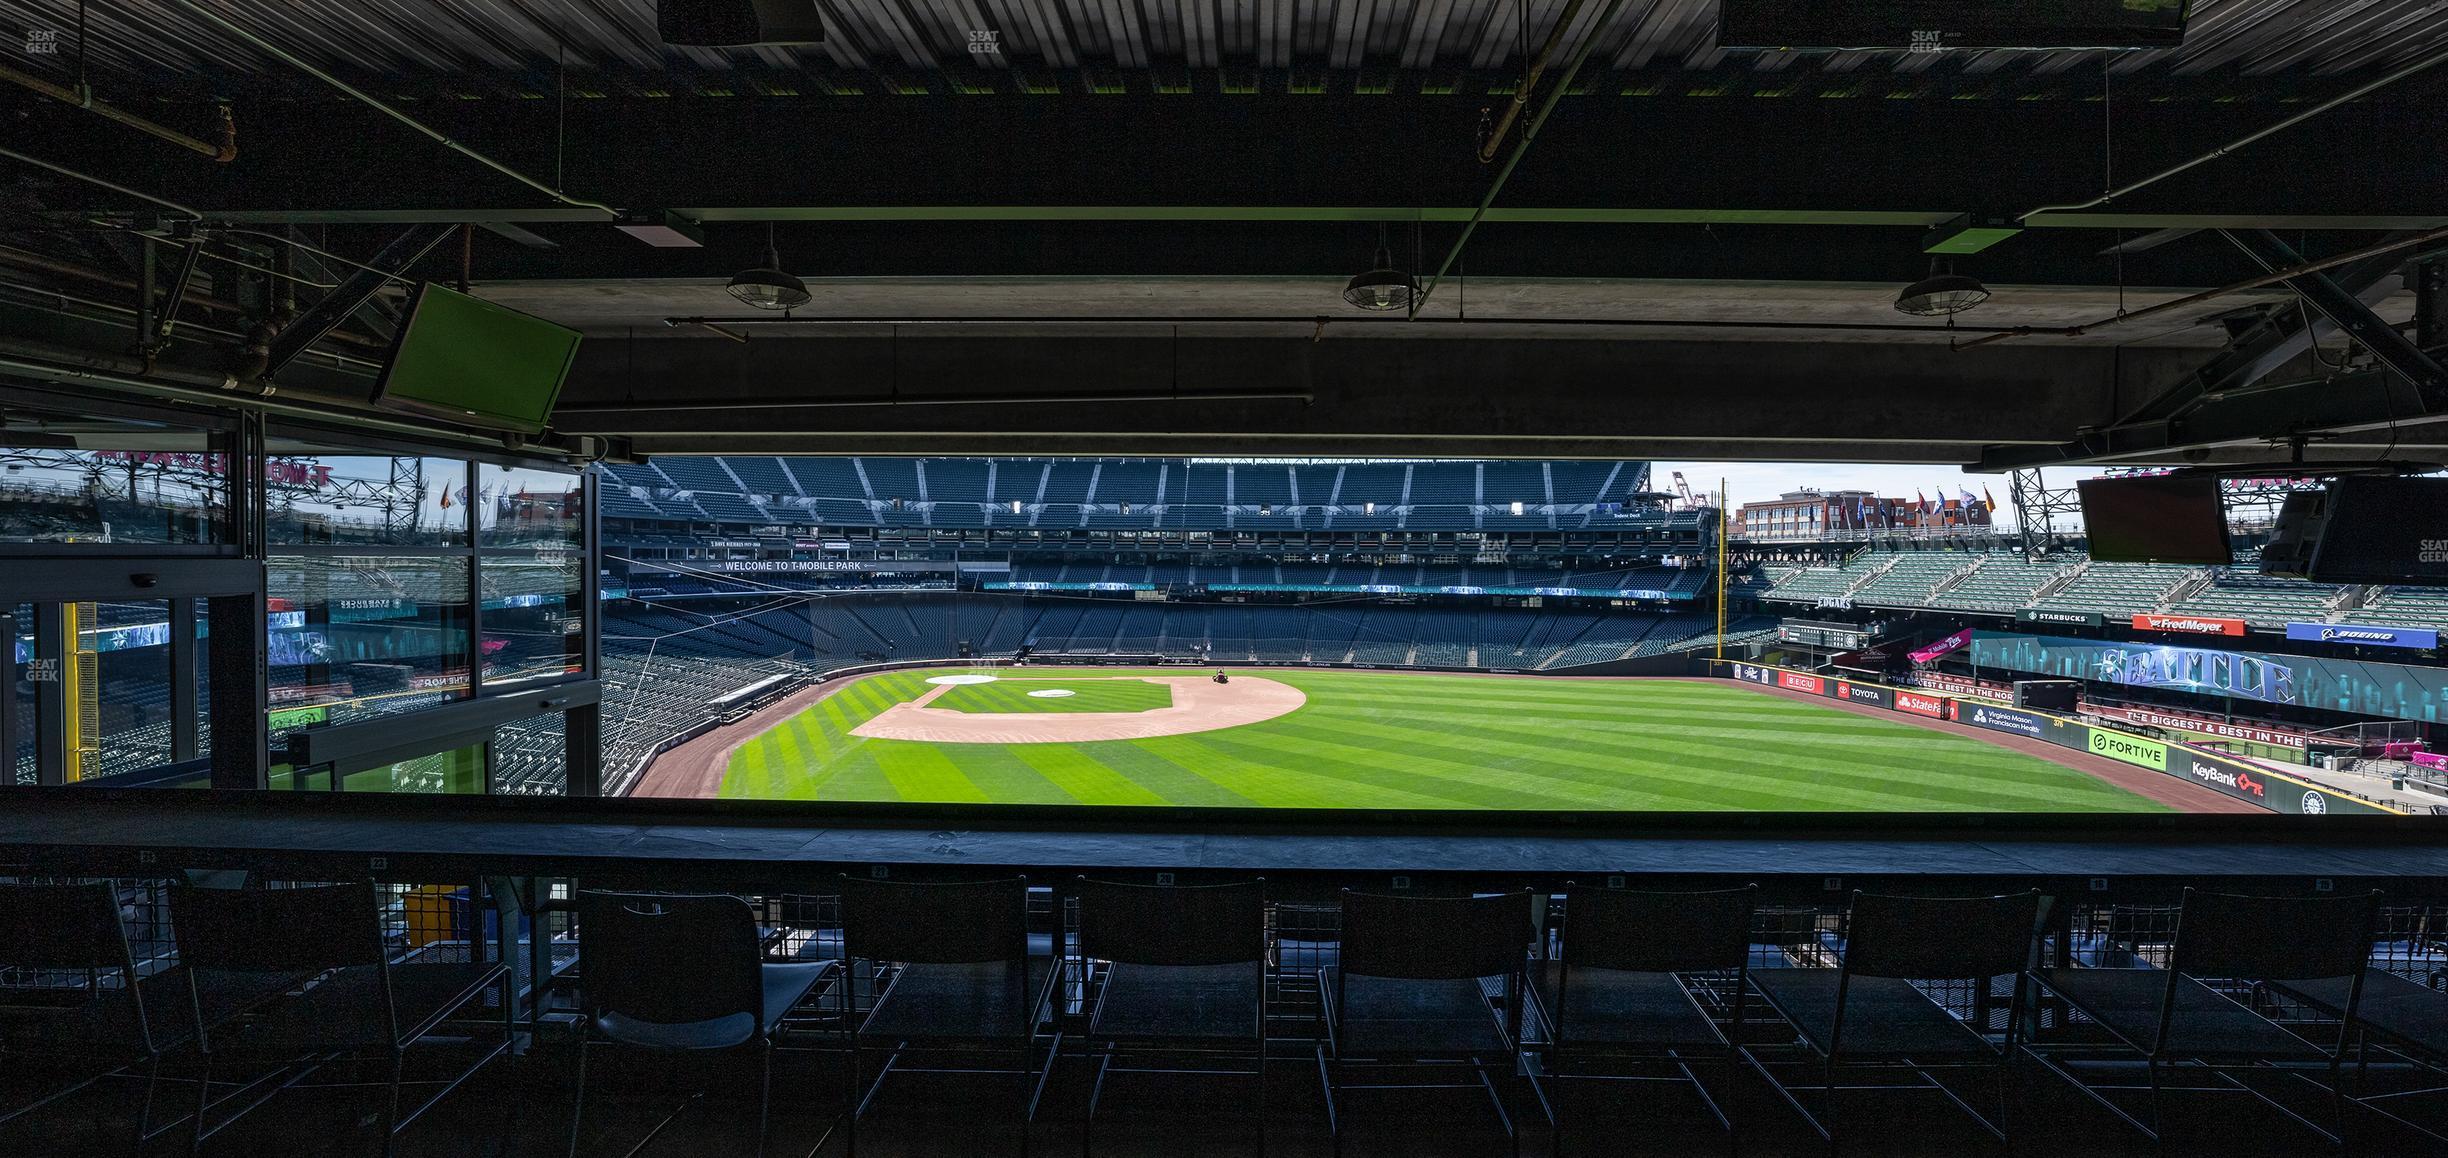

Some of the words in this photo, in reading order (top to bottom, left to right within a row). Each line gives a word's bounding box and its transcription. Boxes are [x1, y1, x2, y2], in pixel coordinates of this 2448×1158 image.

[725, 561, 772, 571] WELCOME
[775, 561, 788, 571] TO
[791, 561, 834, 570] T-MOBILE
[836, 561, 861, 570] PARK
[2040, 613, 2086, 622] STARBUCKS
[2339, 631, 2394, 639] BOEING
[1788, 677, 1813, 689] BECU
[1851, 687, 1879, 700] TOYOTA
[1945, 684, 1965, 693] BEST
[1977, 689, 1993, 698] THE
[1988, 711, 2010, 721] Virginia
[2011, 715, 2032, 724] Mason
[1988, 718, 2020, 729] Franciscan
[2021, 724, 2040, 733] Health
[2126, 711, 2147, 721] THE
[2151, 715, 2202, 731] BIGGEST
[2206, 724, 2214, 732] &
[2218, 725, 2252, 739] BEST
[2256, 730, 2270, 741] IN
[2275, 734, 2303, 746] THE
[2110, 740, 2161, 762] FORTIVE
[2192, 762, 2236, 787] KeyBank
